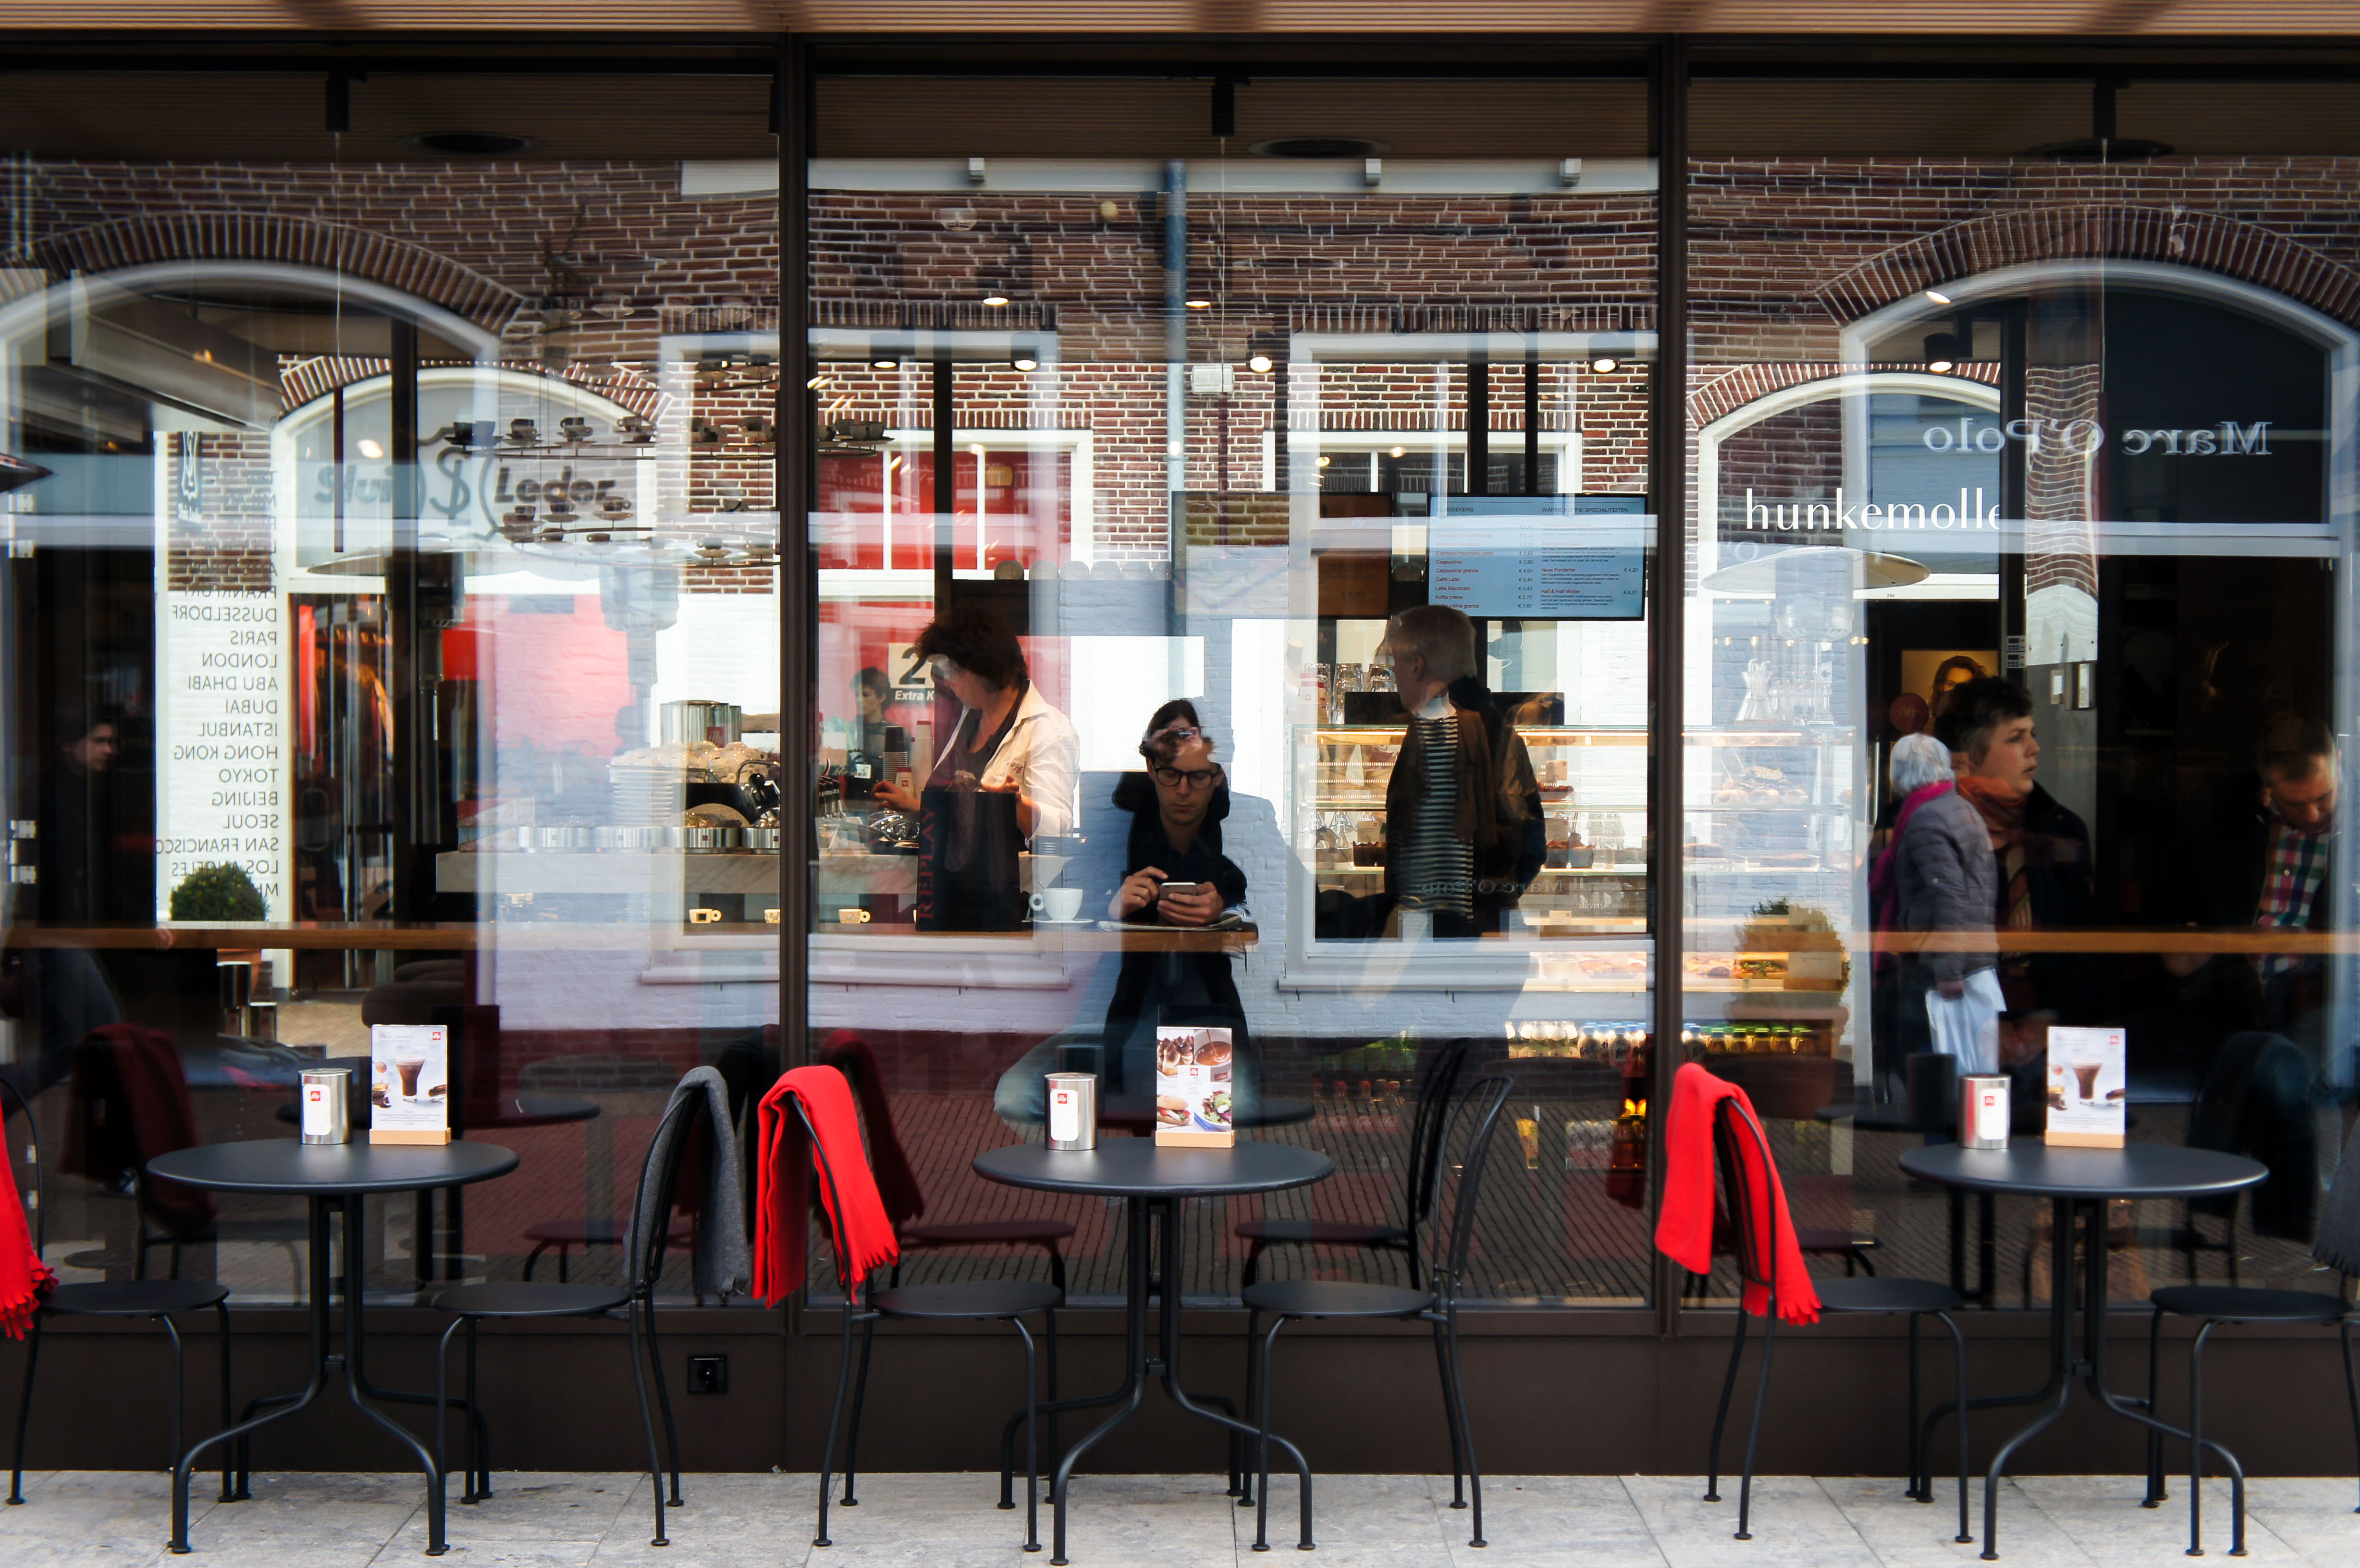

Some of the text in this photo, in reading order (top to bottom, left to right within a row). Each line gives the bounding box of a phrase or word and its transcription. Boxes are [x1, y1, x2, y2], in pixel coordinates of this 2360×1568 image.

[895, 690, 923, 701] Extra
[708, 730, 724, 744] illy
[311, 1092, 320, 1100] illy
[1058, 1094, 1067, 1102] illy
